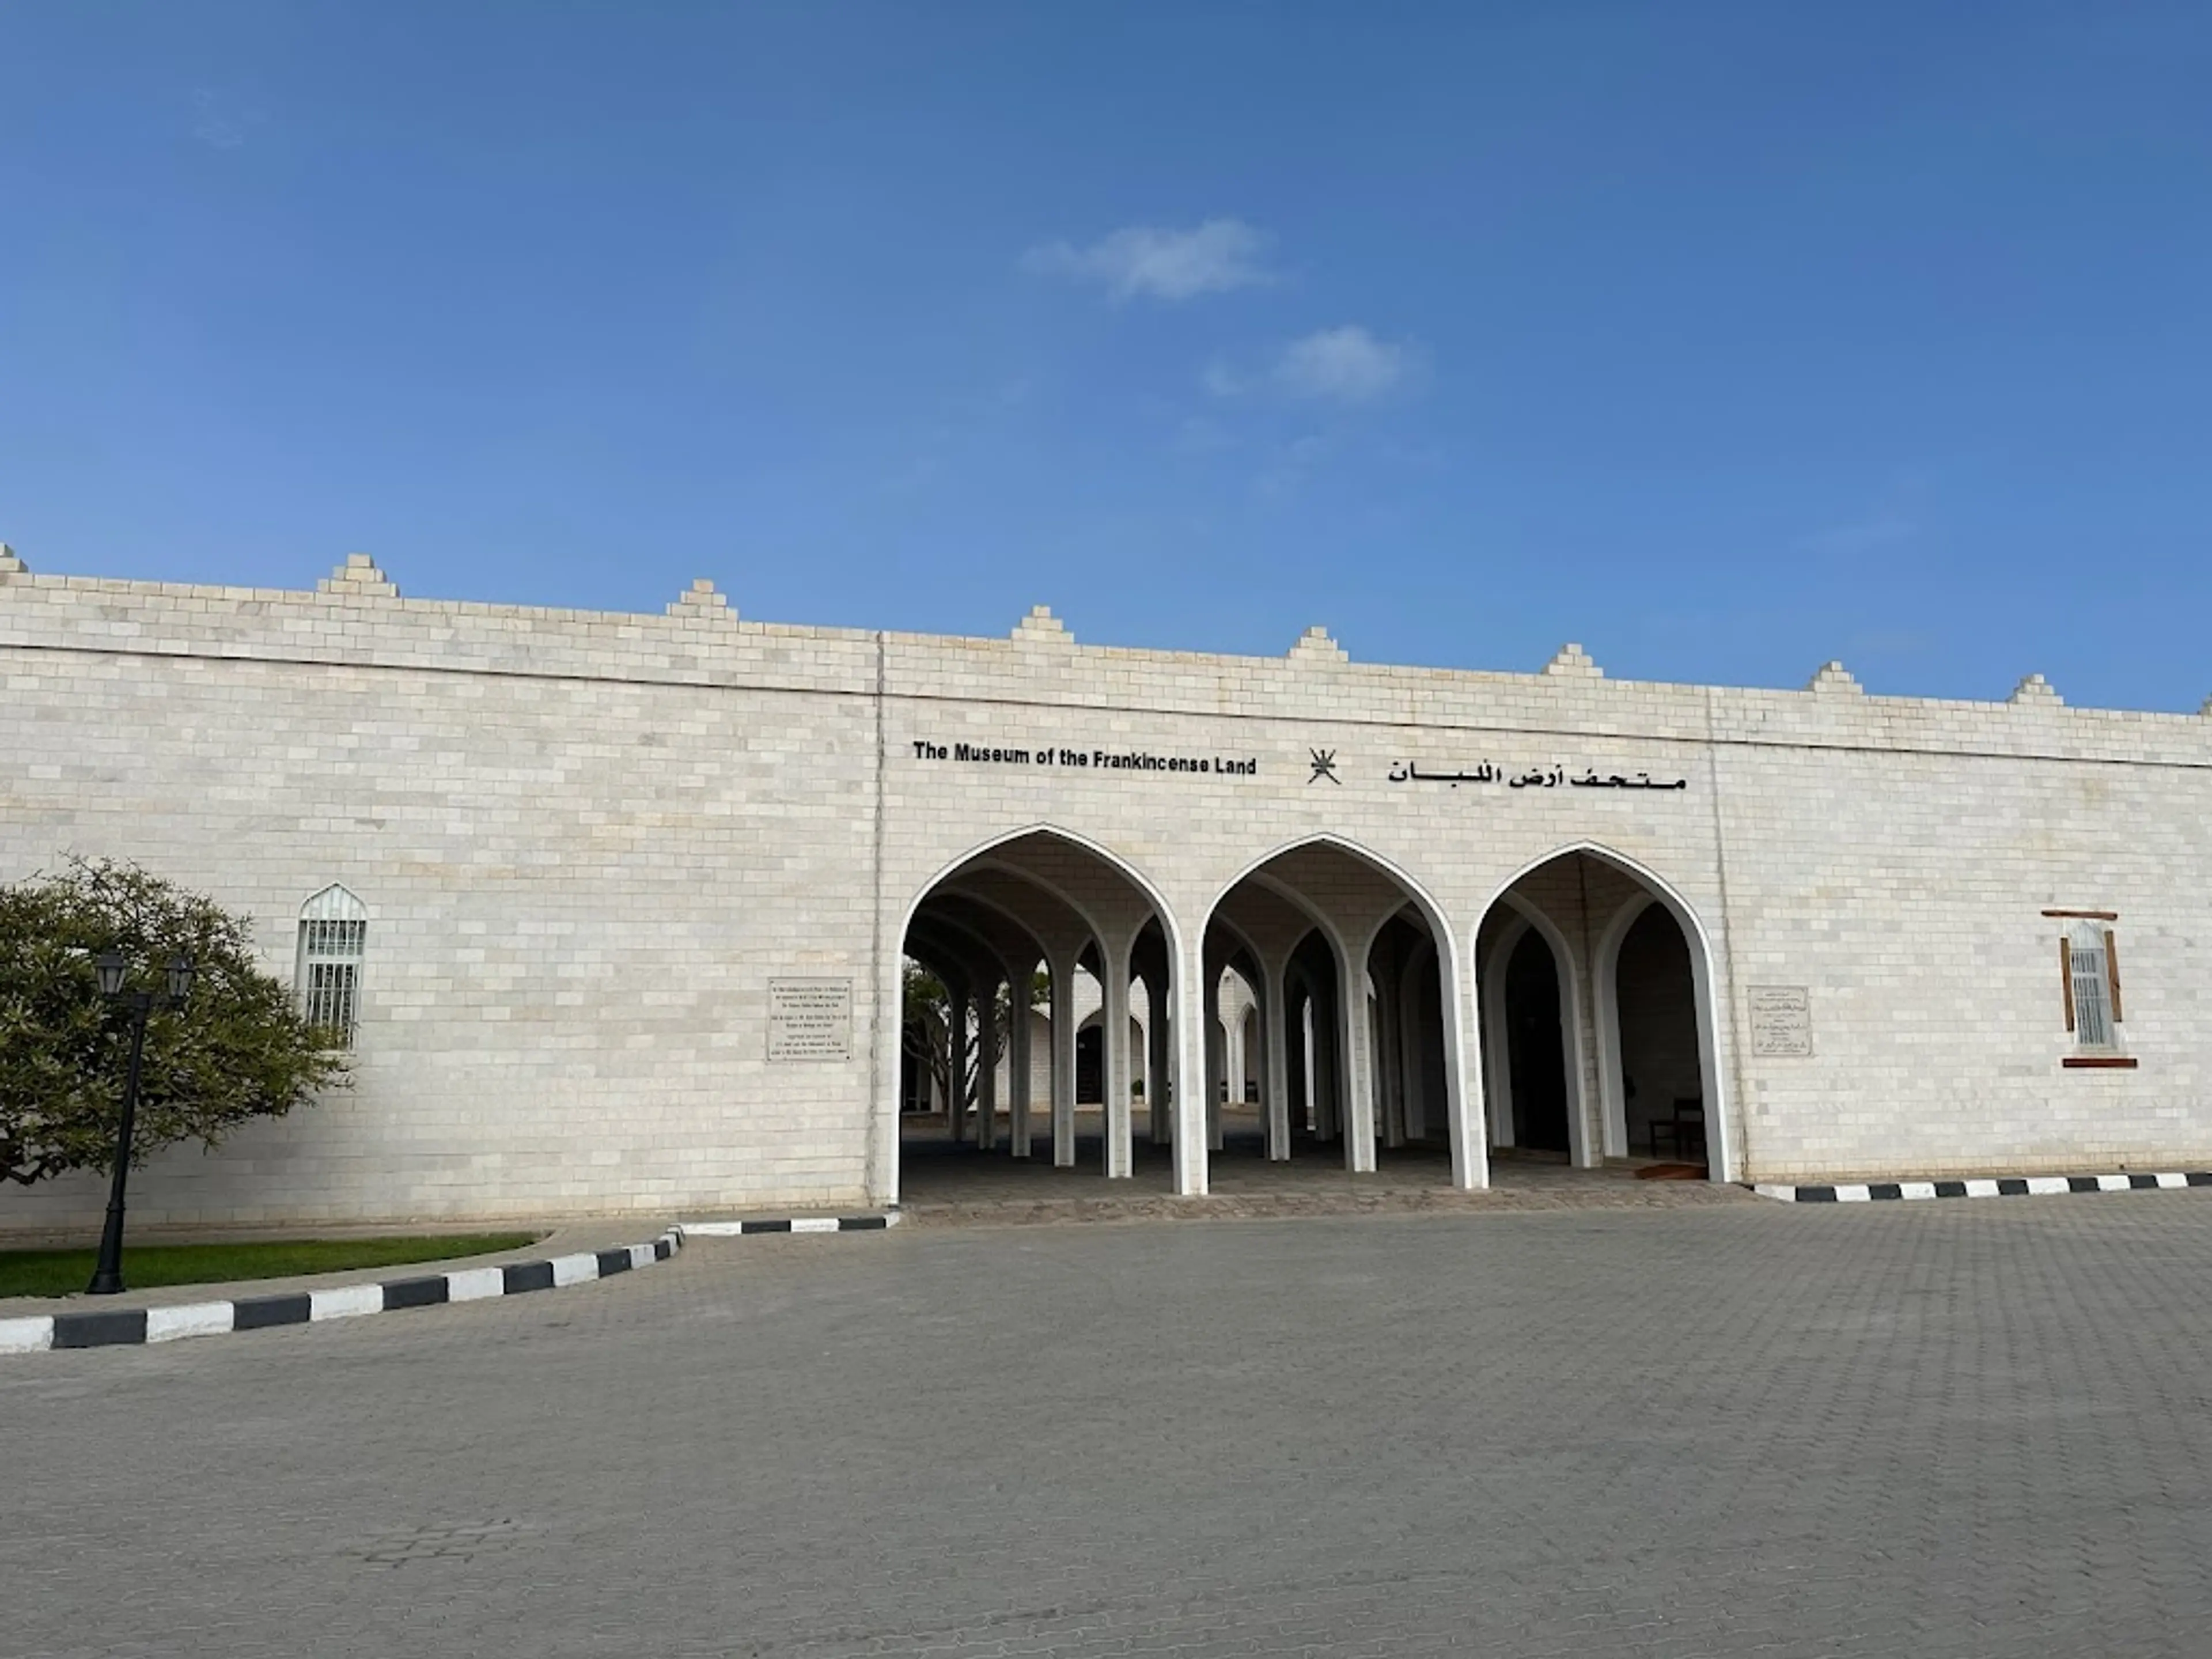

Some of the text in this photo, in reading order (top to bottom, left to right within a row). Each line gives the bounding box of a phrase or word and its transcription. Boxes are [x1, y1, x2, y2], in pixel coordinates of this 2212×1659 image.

[912, 740, 1257, 776] The Museum of the Frankincense Land
[1387, 758, 1687, 790] متحف أرض اللبان
